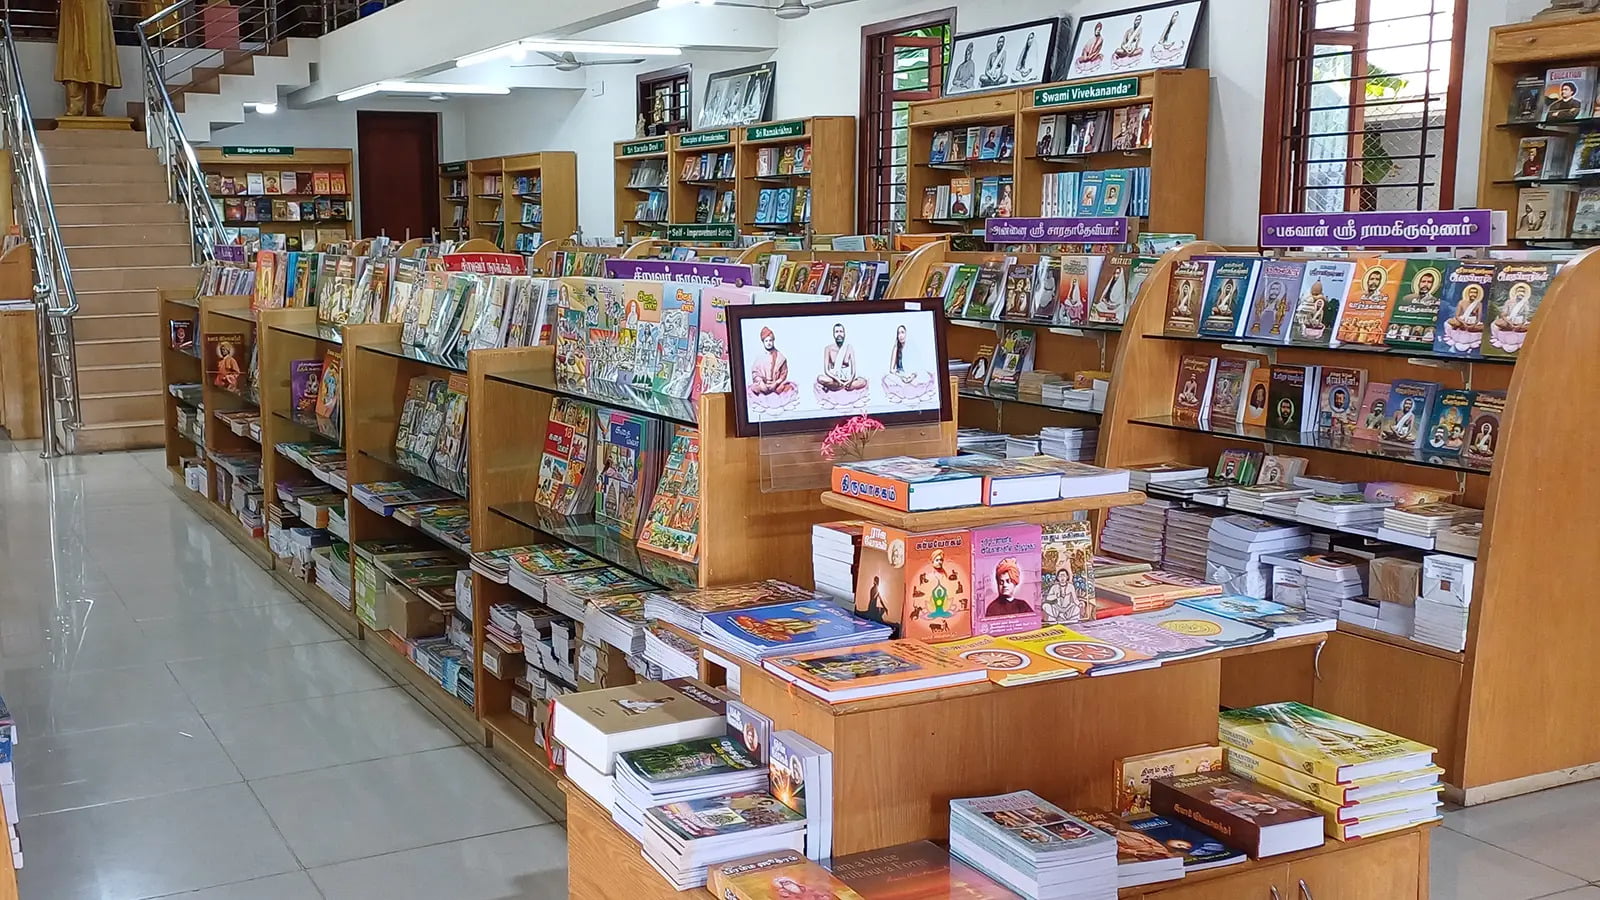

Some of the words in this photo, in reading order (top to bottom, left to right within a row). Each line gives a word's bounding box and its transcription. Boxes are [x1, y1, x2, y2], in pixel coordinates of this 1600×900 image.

[1042, 90, 1070, 103] Swami
[1071, 83, 1129, 100] Vivekananda
[755, 129, 763, 138] Sri
[763, 126, 793, 137] Ramakrishna
[237, 146, 266, 155] Bhagavad
[634, 144, 649, 153] Sarada
[649, 142, 659, 152] Devi
[672, 227, 683, 236] Self
[687, 228, 718, 238] Improvement
[992, 221, 1027, 240] அன்னை
[1029, 221, 1045, 237] ஸ்ரீ
[1276, 219, 1329, 237] பகவான்
[1333, 219, 1357, 240] ஸ்ரீ
[1360, 216, 1471, 240] ராமகிருஷ்ணர்
[841, 473, 897, 502] திருவாசகம்
[862, 851, 899, 867] Voice
[836, 865, 883, 882] without
[891, 856, 929, 871] Form
